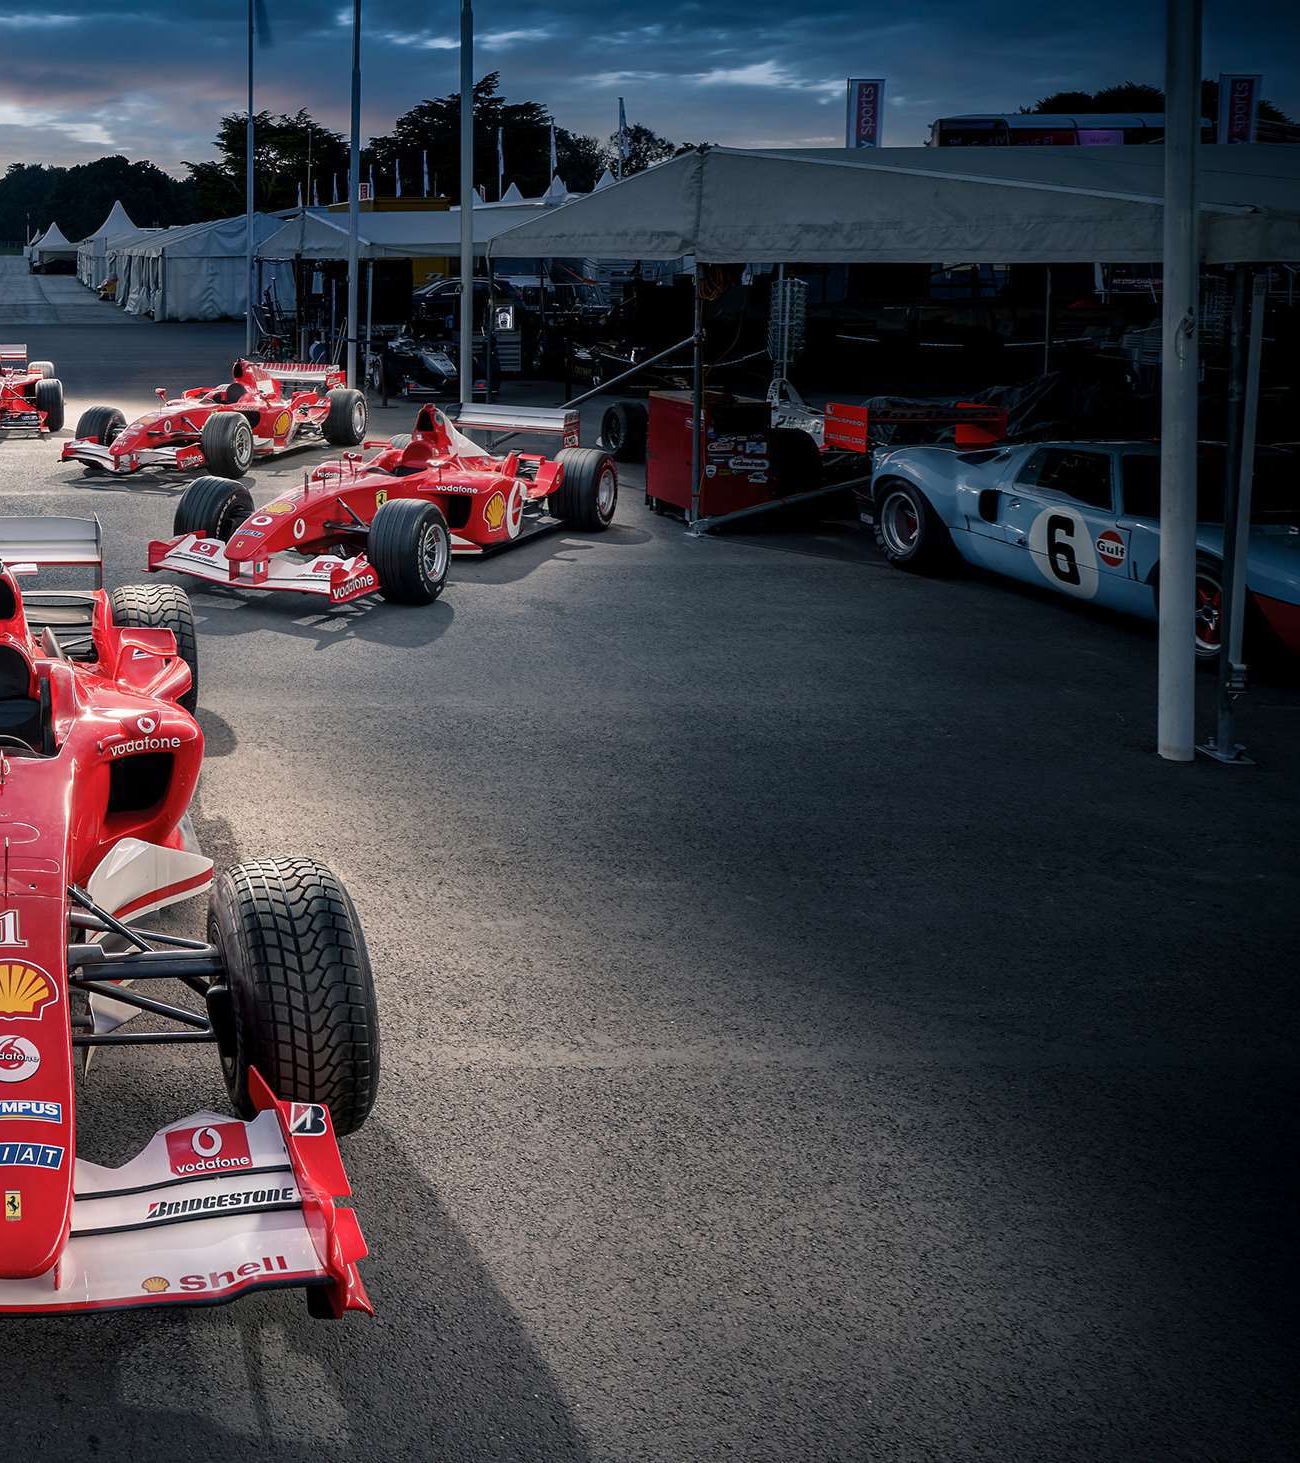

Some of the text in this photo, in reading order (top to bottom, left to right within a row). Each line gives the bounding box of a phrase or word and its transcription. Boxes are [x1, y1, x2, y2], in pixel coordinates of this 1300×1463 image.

[860, 87, 875, 135] sports
[436, 484, 478, 494] vodafone
[1047, 514, 1080, 586] 6
[1096, 540, 1125, 558] Gulf
[332, 574, 374, 600] vodafone
[110, 736, 181, 757] vodafone
[175, 1155, 250, 1174] vodafone
[146, 1187, 294, 1220] BRIDGESTONE
[179, 1255, 288, 1292] Shell
